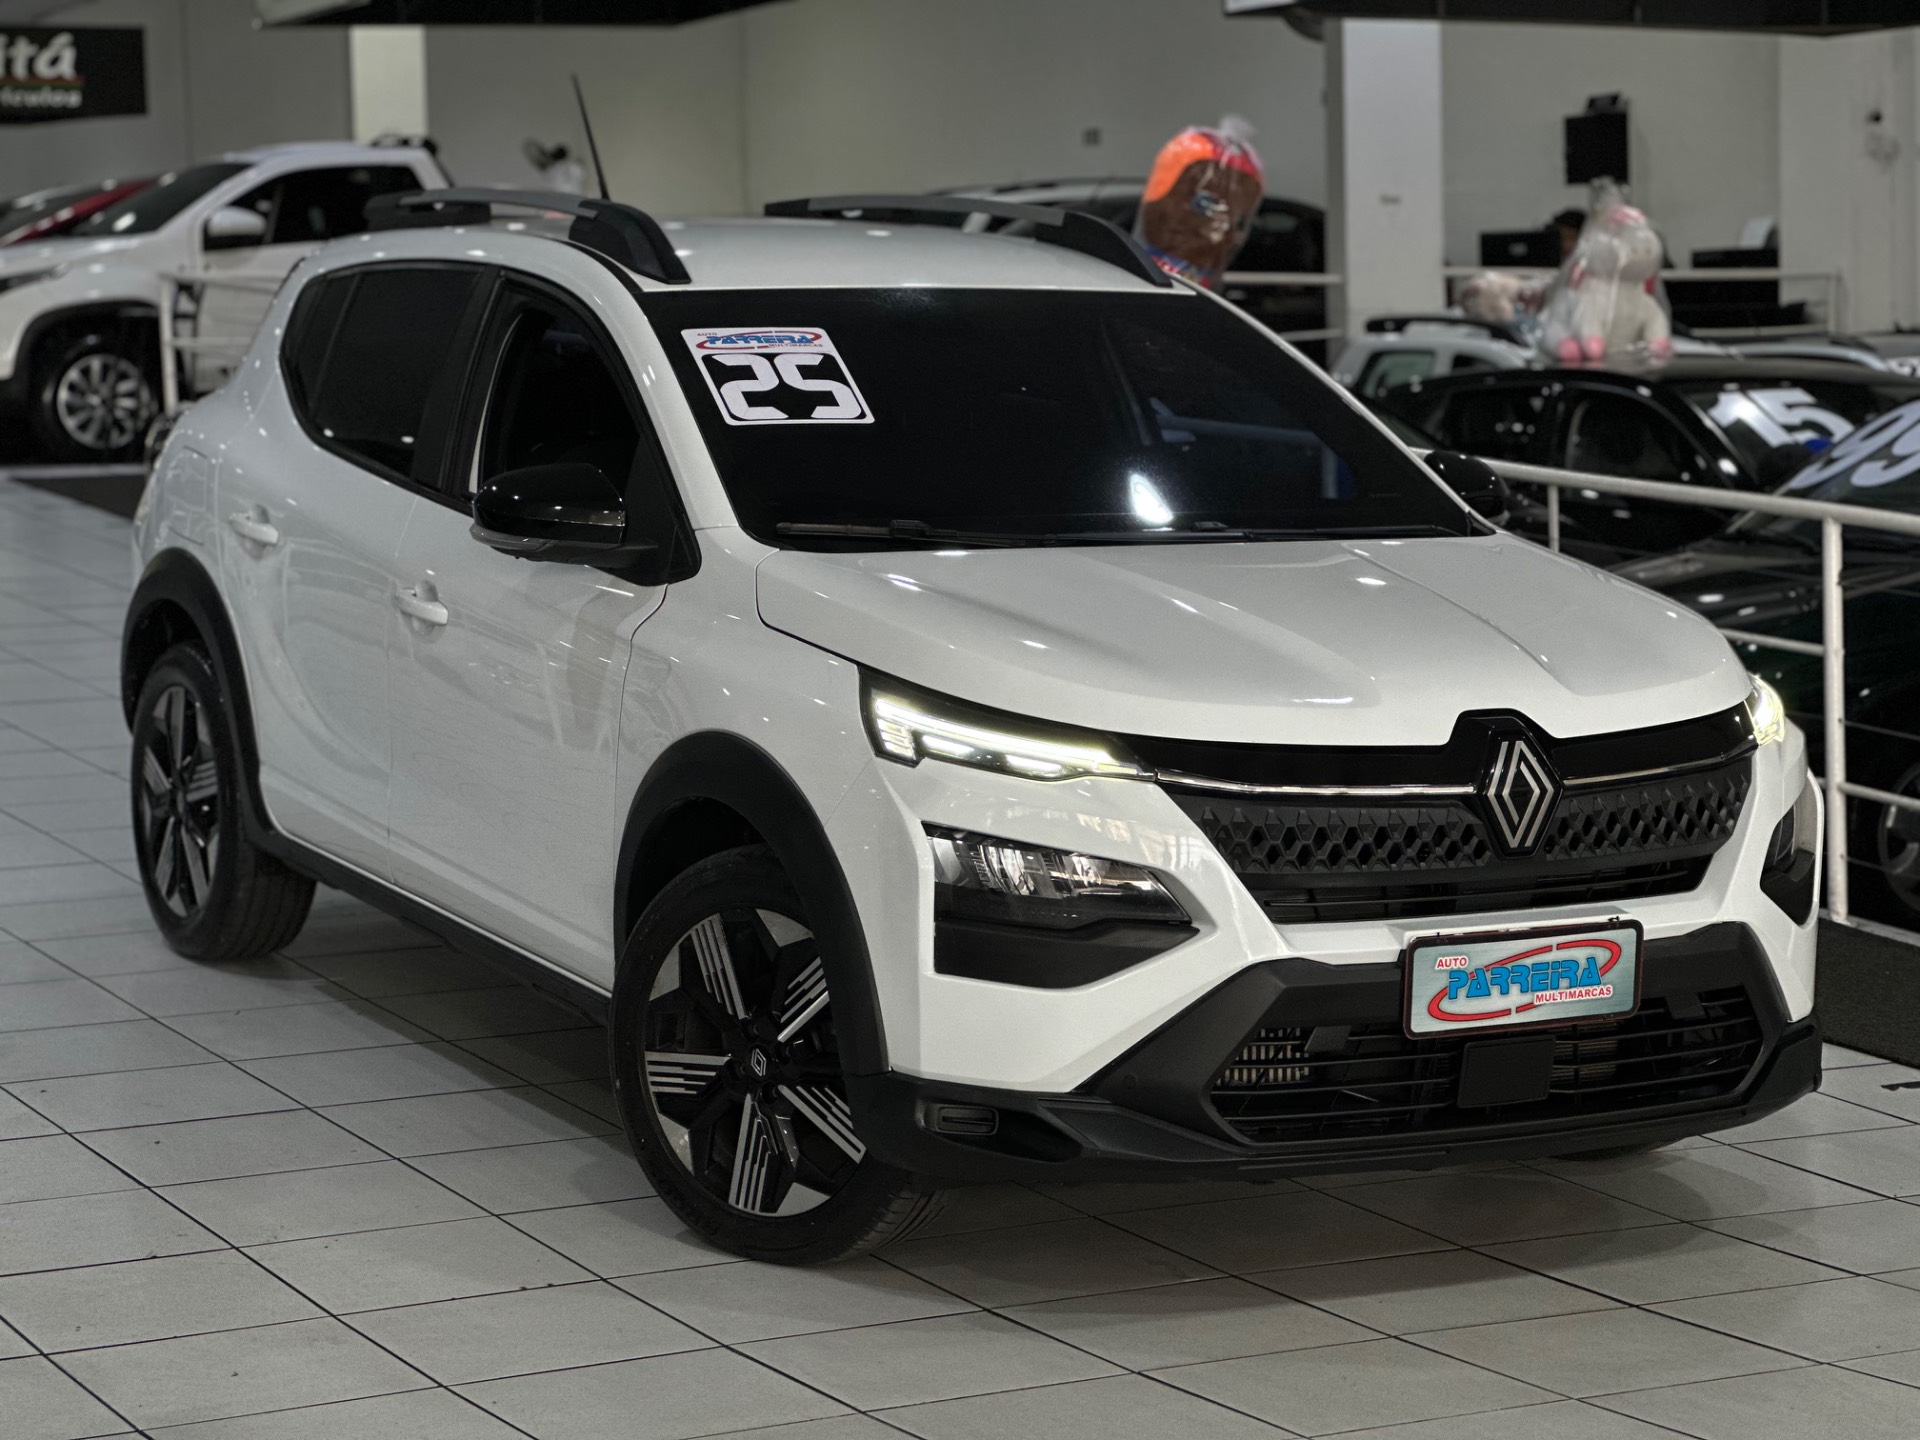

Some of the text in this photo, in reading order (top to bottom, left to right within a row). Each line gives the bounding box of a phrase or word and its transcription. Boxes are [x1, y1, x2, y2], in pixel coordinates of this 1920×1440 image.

[706, 334, 814, 345] PARREIRA
[711, 353, 862, 420] 25
[1437, 957, 1467, 968] AUTO
[1448, 957, 1602, 1000] PARREIRA
[1535, 986, 1612, 1003] MULTIMARCAS
